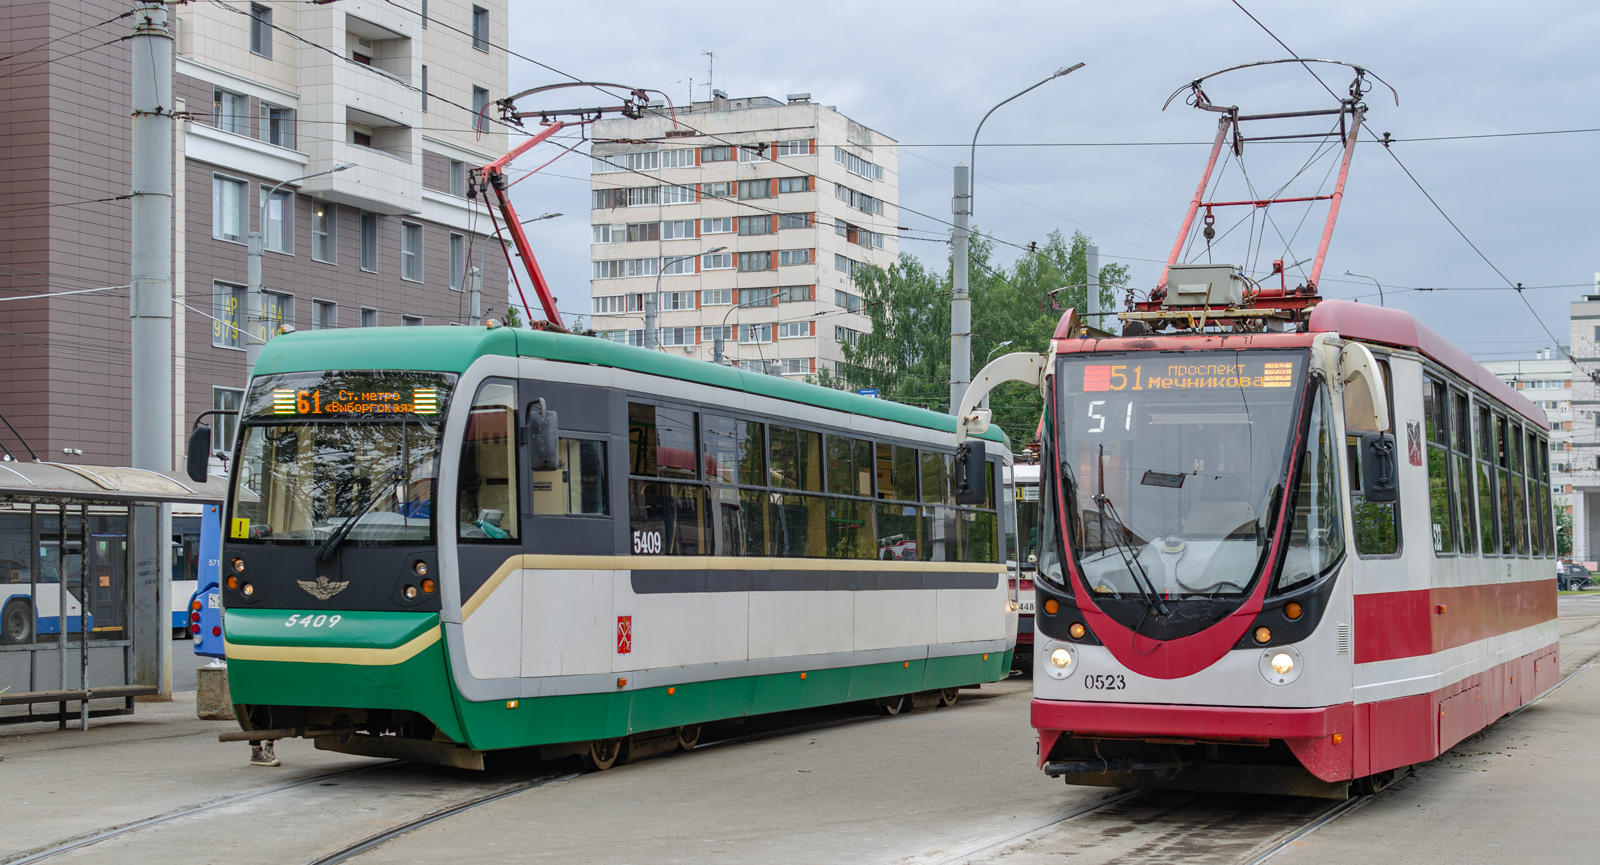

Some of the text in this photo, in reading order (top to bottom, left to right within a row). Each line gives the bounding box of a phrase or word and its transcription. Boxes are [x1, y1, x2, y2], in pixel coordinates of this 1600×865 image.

[1110, 365, 1143, 391] 51
[1168, 363, 1246, 376] проспект
[296, 389, 323, 414] 61
[1559, 406, 1567, 414] 51
[1087, 400, 1133, 433] 51
[633, 530, 662, 554] 5409
[284, 614, 342, 628] 5409
[1084, 674, 1126, 690] 0523
